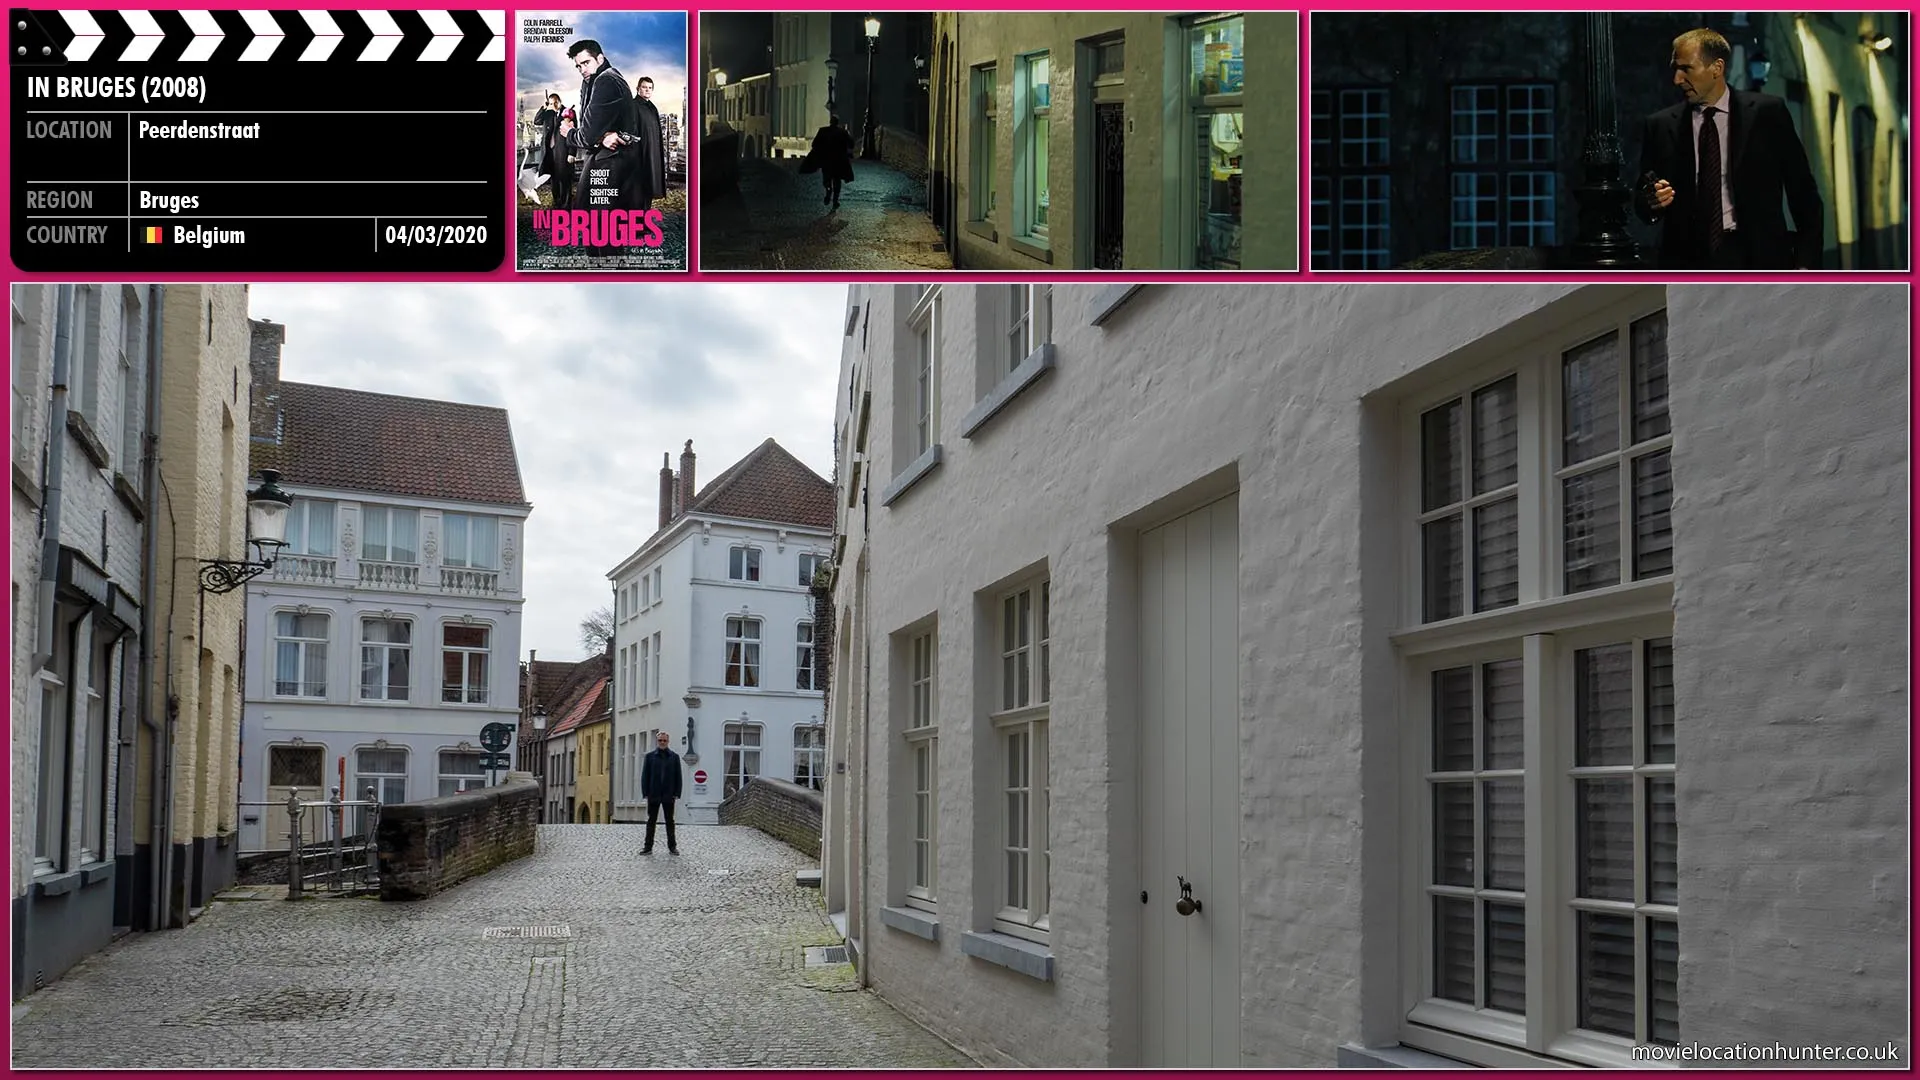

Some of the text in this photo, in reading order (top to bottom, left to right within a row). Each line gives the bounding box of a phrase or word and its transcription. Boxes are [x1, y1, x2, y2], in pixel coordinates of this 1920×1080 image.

[523, 19, 563, 27] COLIN FARRELL
[523, 27, 573, 35] BRENDAN GLEESON
[523, 35, 564, 43] RALPH FIENNES
[590, 169, 610, 177] SHOOT
[590, 177, 609, 185] FIRST.
[590, 188, 619, 197] SIGHTSEE
[590, 196, 610, 205] LATER.
[533, 209, 664, 247] IN BRUGES
